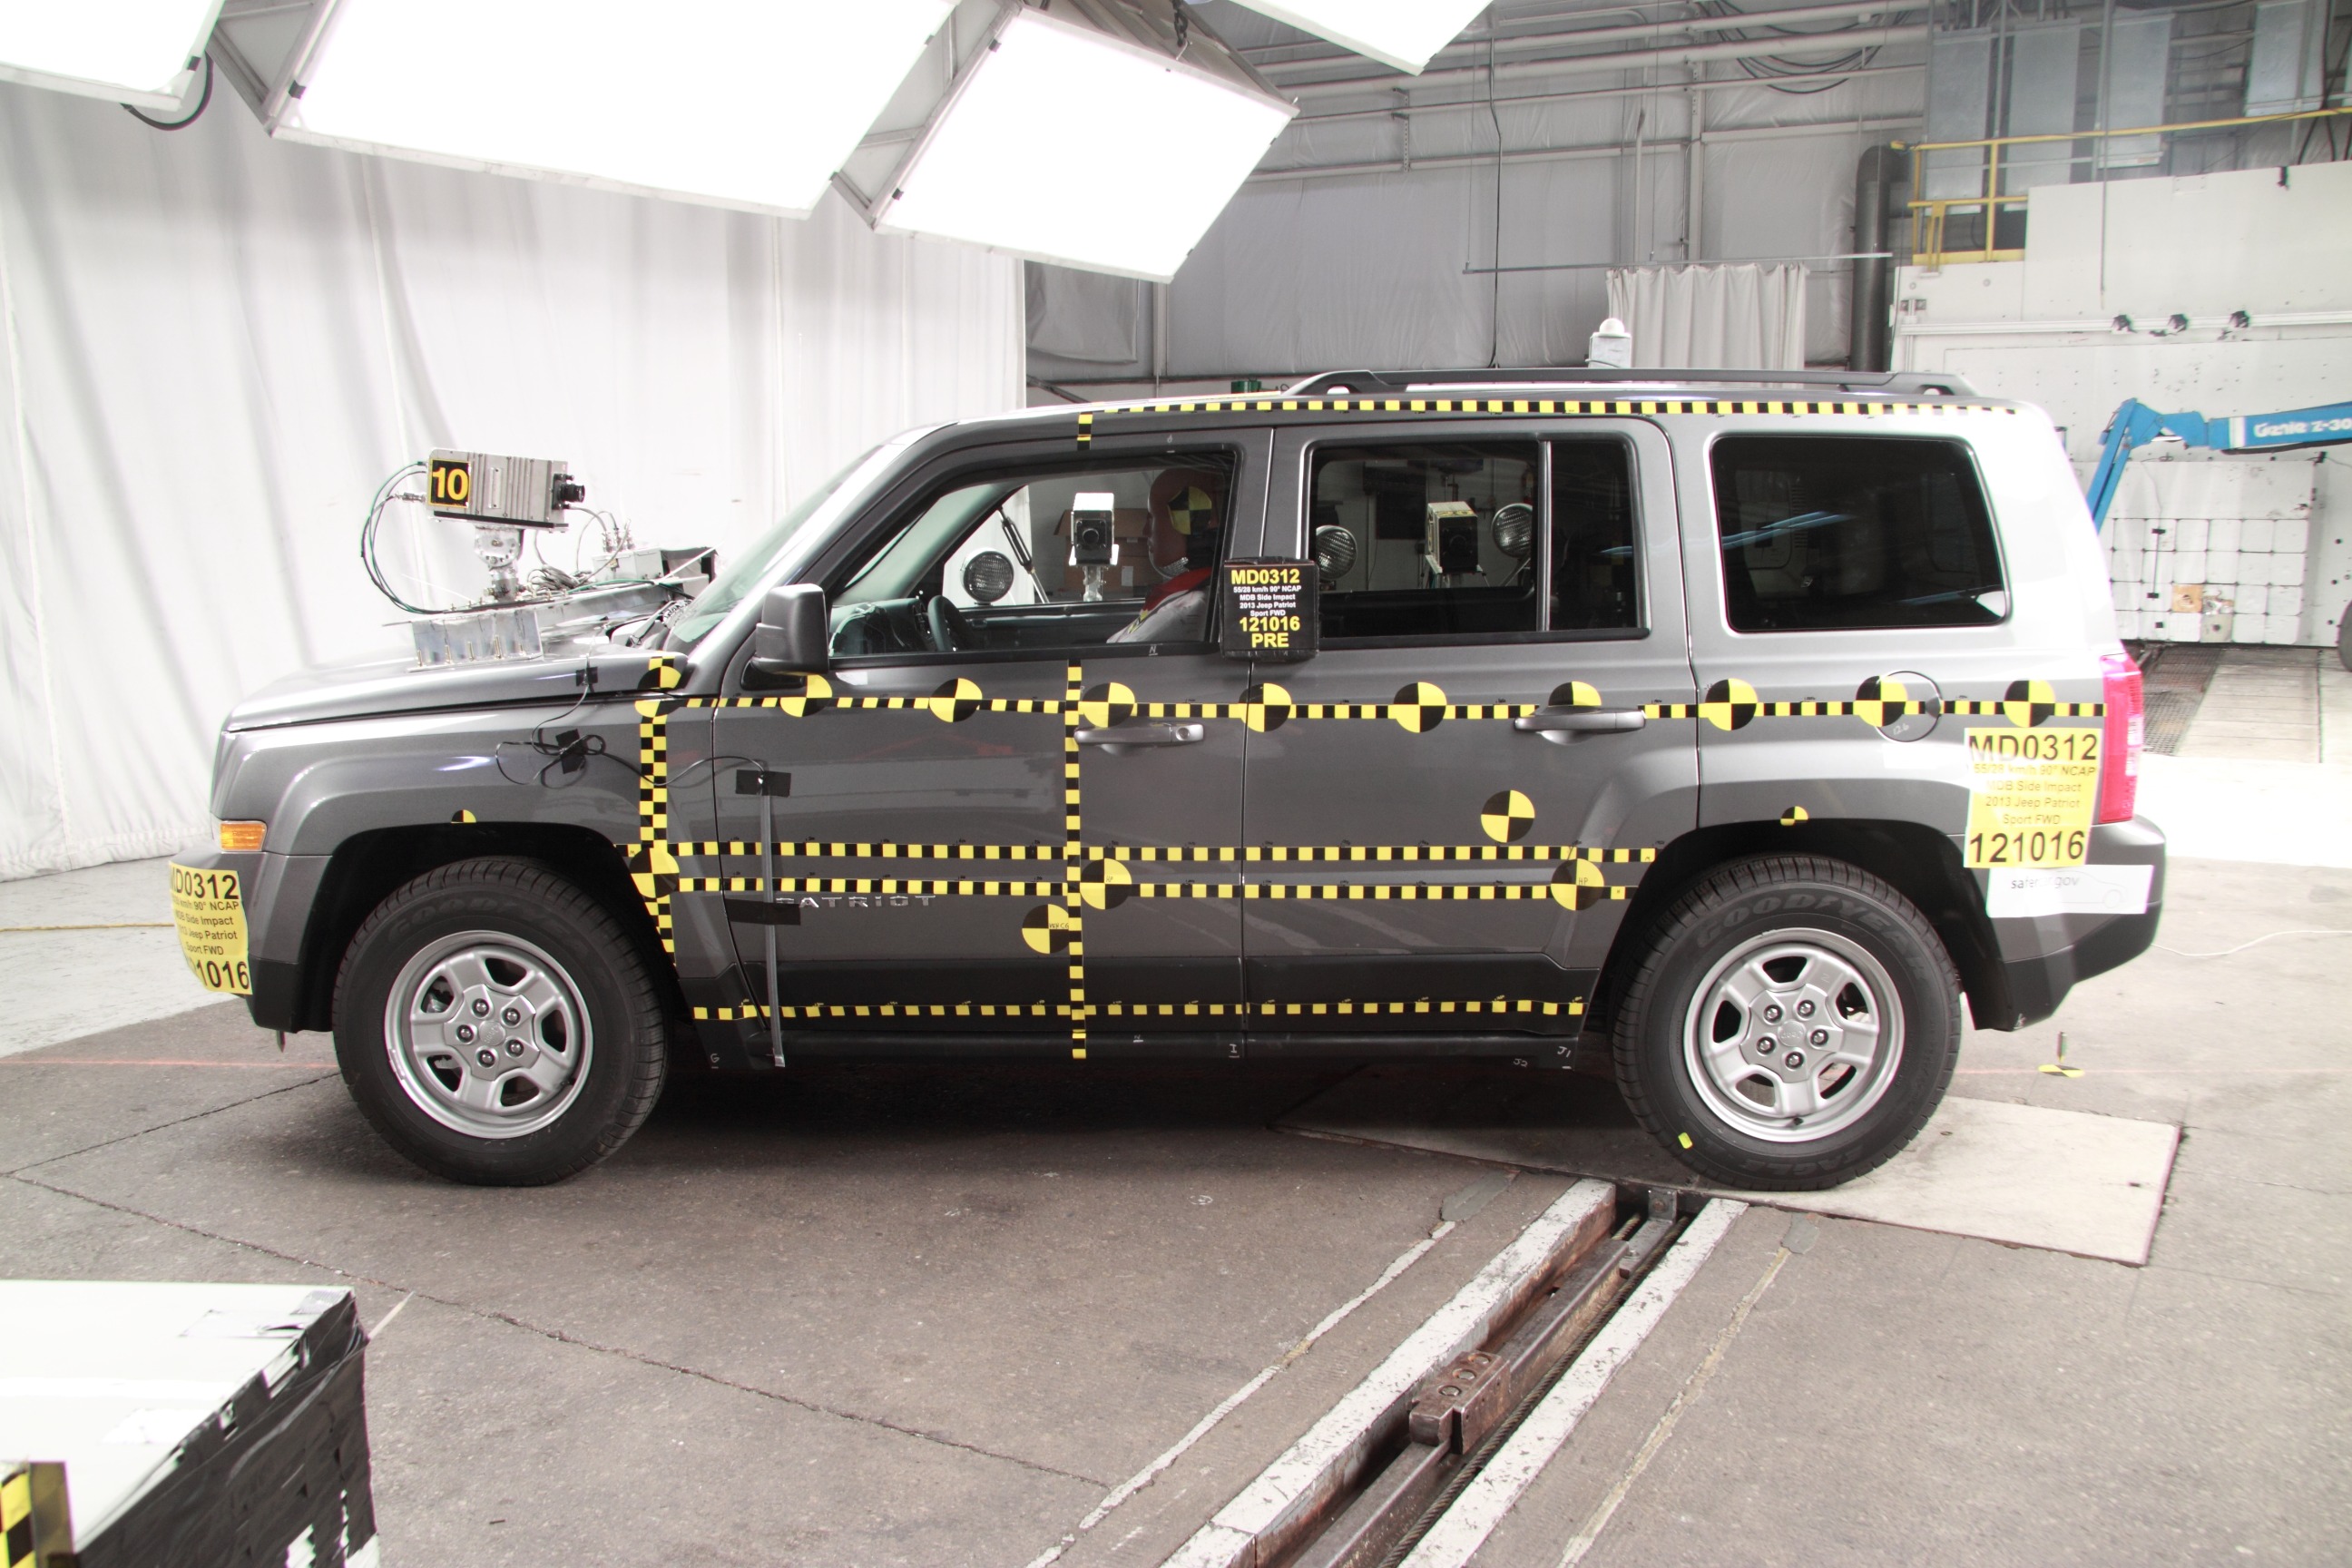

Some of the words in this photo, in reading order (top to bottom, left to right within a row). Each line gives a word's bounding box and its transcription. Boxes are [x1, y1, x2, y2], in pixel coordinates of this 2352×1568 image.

[2253, 419, 2308, 438] Genie
[432, 466, 469, 501] 10
[1230, 569, 1300, 585] MD0312
[1233, 585, 1251, 593] 55/28
[1281, 584, 1302, 593] NCAP
[1240, 593, 1256, 602] MDB
[1273, 593, 1296, 603] Impact
[1257, 602, 1273, 610] Jeep
[1274, 601, 1296, 609] Patriot
[1250, 610, 1269, 618] Sport
[1269, 609, 1287, 617] FWD
[1240, 616, 1300, 632] 121016
[1251, 632, 1289, 648] PRE
[1969, 733, 2098, 761] MD0312
[2062, 765, 2096, 777] NCAP
[2016, 780, 2041, 791] Side
[2044, 780, 2082, 794] Impact
[1985, 796, 2011, 807] 2013
[2014, 797, 2041, 809] Jeep
[2044, 797, 2080, 808] Patriot
[2003, 813, 2033, 826] Sport
[2036, 814, 2062, 825] FWD
[1969, 830, 2085, 863] 121016
[210, 900, 240, 911] NCAP
[775, 895, 936, 908] PATRIOT
[185, 913, 200, 925] Side
[201, 916, 233, 926] Impact
[205, 930, 238, 941] Patriot
[203, 945, 224, 956] FWD
